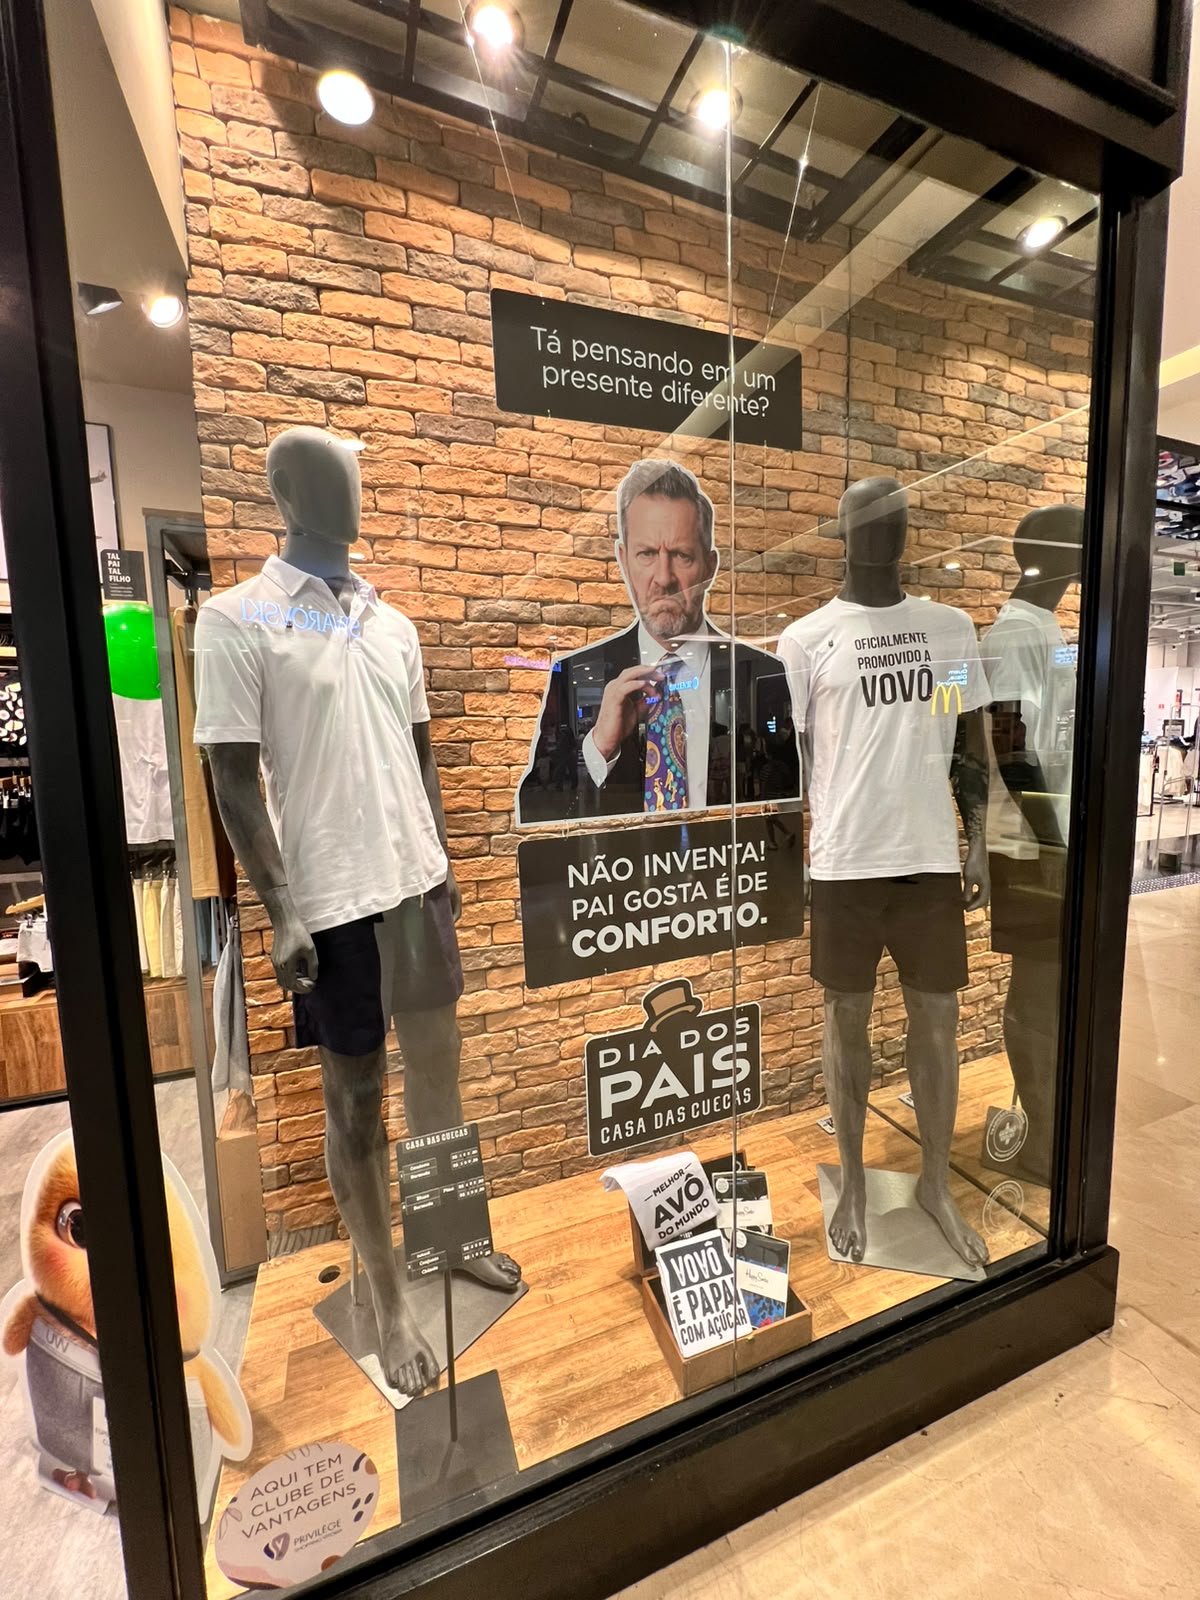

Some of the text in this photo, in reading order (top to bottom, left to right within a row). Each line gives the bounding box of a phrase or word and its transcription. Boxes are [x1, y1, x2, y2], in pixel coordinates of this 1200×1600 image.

[530, 326, 776, 392] Tá pensando em um
[542, 365, 770, 417] presente diferente?
[854, 632, 928, 650] OFICIALMENTE
[857, 650, 932, 670] PROMOVIDO A
[860, 664, 934, 708] VOVÔ
[567, 840, 766, 888] NÃO INVENTA!
[572, 871, 768, 921] PAI GOSTA É DE
[571, 901, 768, 959] CONFORTO.
[599, 1017, 750, 1069] DIA DOS
[600, 1042, 751, 1120] PAIS
[405, 1128, 468, 1150] CASA DAS CUECAS
[601, 1087, 752, 1144] CASA DAS CUECAS
[652, 1168, 685, 1197] MELHOR
[654, 1173, 704, 1229] AVÔ
[658, 1198, 710, 1239] DO MUNDO
[670, 1241, 723, 1287] VOVÔ
[672, 1295, 686, 1326] É
[680, 1308, 748, 1346] COM AÇÚCAR
[45, 1329, 70, 1353] UW
[250, 1453, 342, 1501] AQUI TEM
[251, 1470, 345, 1517] CLUBE DE
[241, 1483, 357, 1539] VANTAGENS
